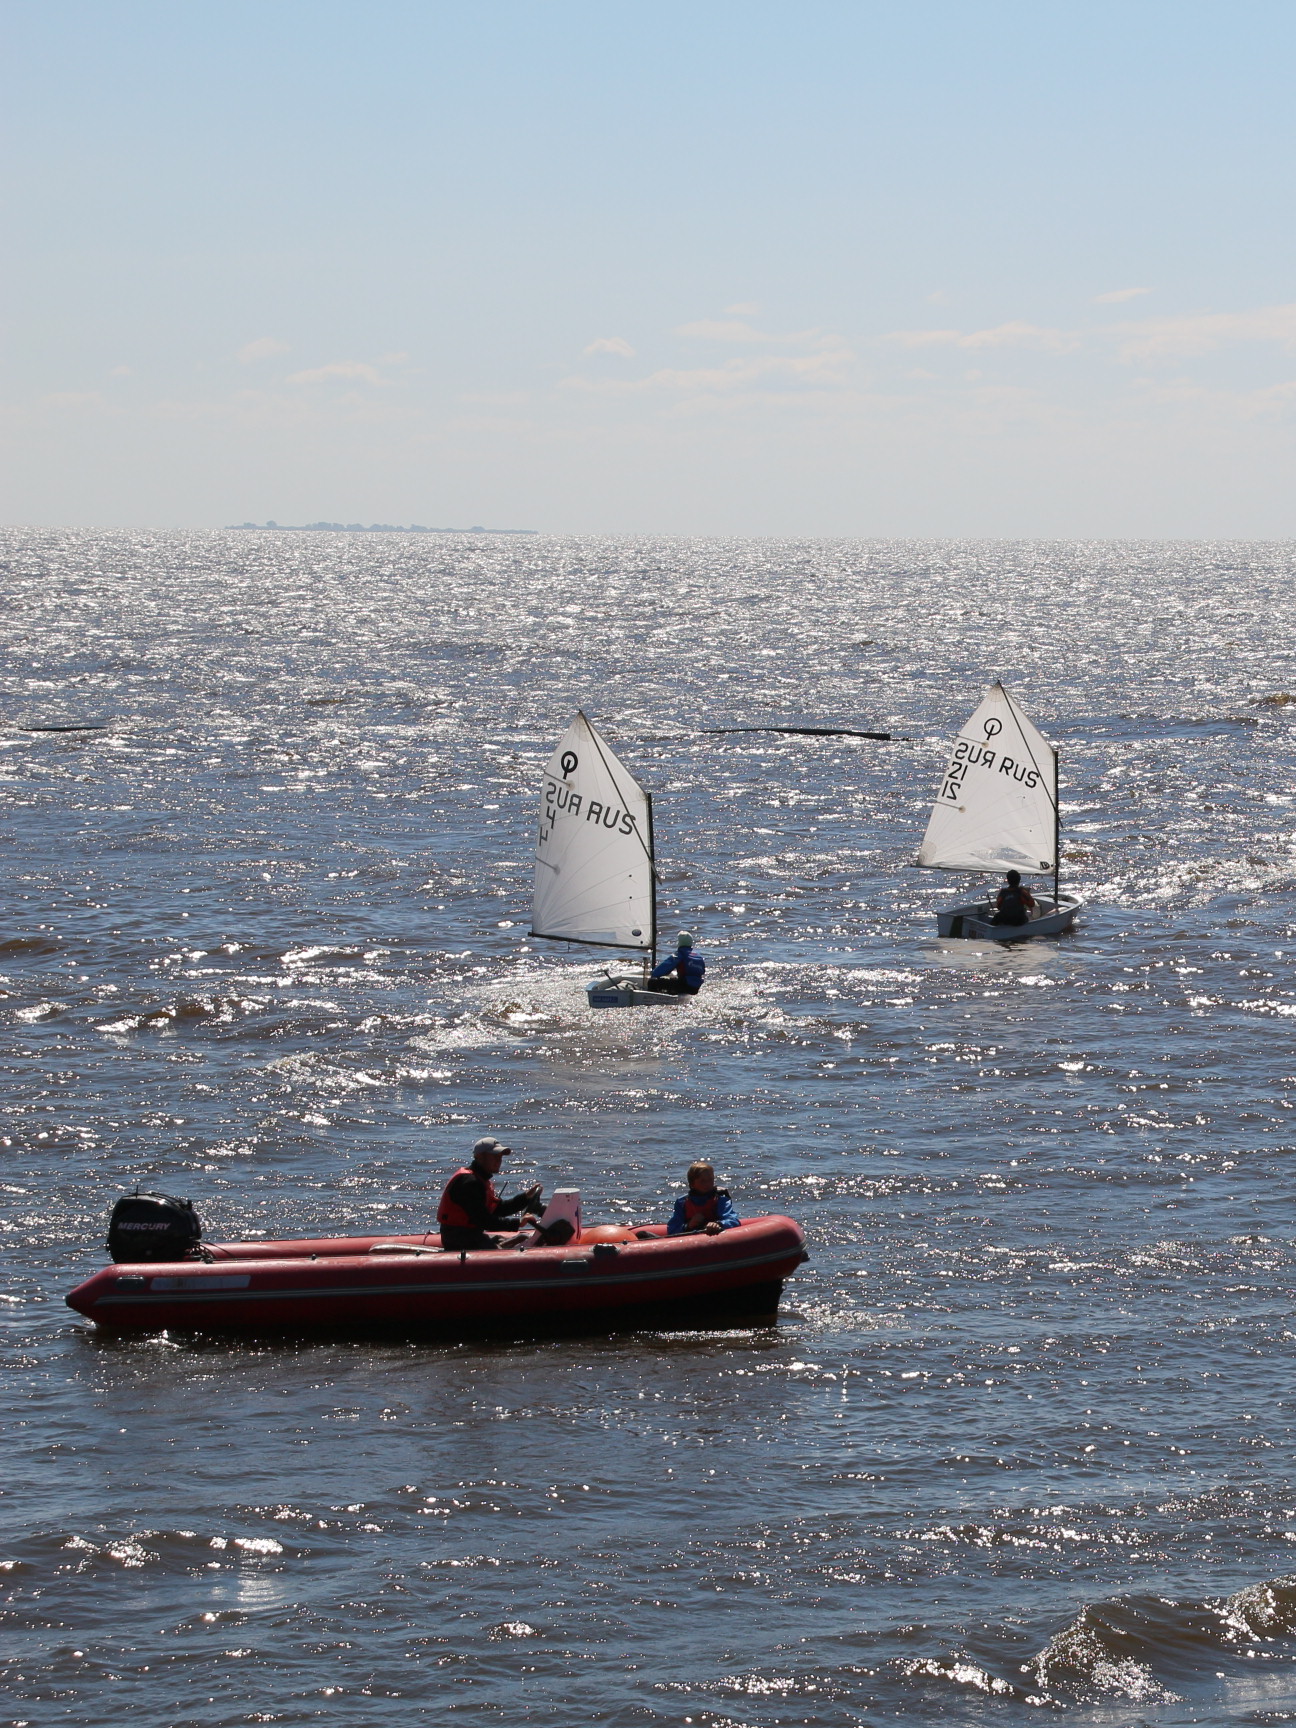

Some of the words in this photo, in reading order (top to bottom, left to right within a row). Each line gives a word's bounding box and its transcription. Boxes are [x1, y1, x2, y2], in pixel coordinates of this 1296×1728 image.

[947, 761, 968, 781] 21
[998, 756, 1040, 789] RUS
[546, 808, 556, 830] 4
[586, 801, 637, 835] RUS
[117, 1222, 171, 1230] MERCURY
